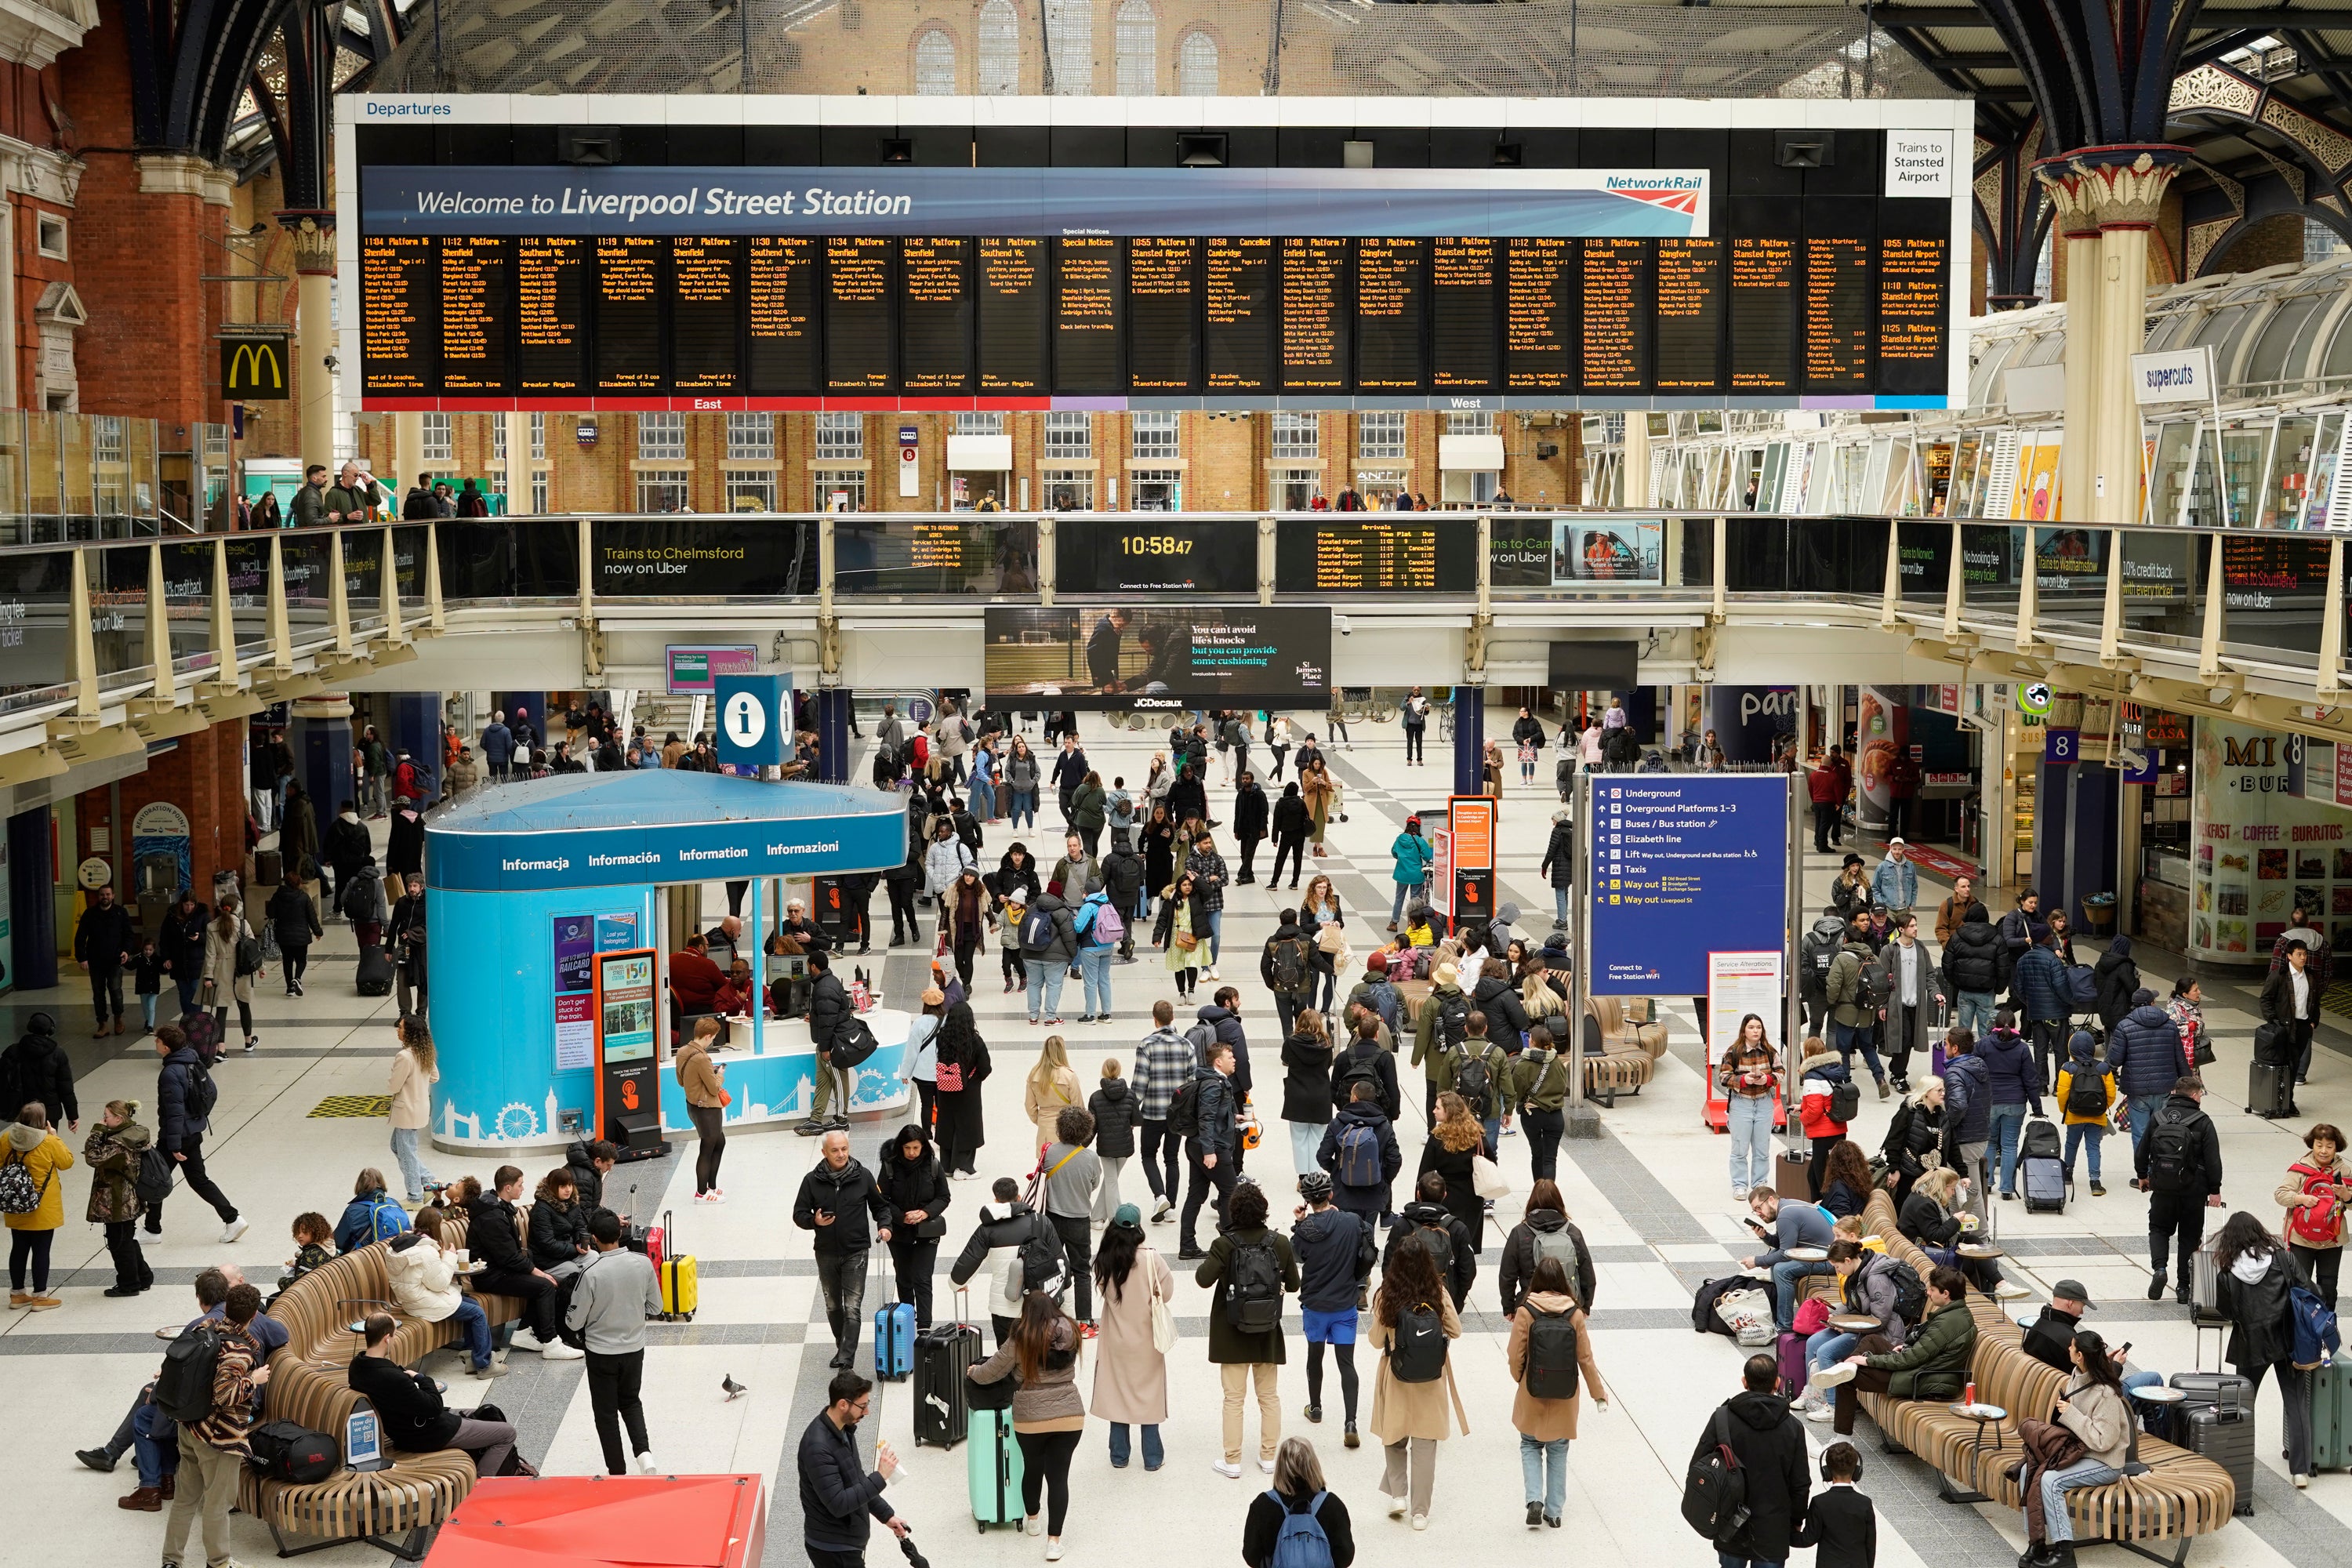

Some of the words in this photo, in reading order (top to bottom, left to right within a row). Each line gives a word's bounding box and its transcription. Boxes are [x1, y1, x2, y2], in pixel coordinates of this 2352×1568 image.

[368, 103, 450, 117] Departures
[1897, 143, 1927, 152] Trains
[1930, 144, 1942, 153] to
[1895, 157, 1944, 167] Stansted
[1899, 172, 1939, 183] Airport
[417, 191, 524, 214] Welcome
[532, 194, 554, 213] to
[561, 188, 698, 222] Liverpool
[704, 188, 795, 214] Street
[804, 188, 911, 215] Station
[364, 249, 395, 257] Shenfield
[2147, 364, 2192, 392] supercuts
[695, 399, 721, 408] East
[1450, 398, 1481, 409] West
[604, 548, 644, 559] Trains
[647, 549, 660, 559] to
[664, 547, 743, 559] Chelmsford
[1900, 546, 1911, 559] Trains
[1911, 549, 1917, 559] to
[1917, 547, 1934, 561] Norwich
[1964, 550, 1970, 563] No
[1971, 551, 1991, 567] booking
[1991, 552, 1999, 564] fee
[605, 565, 633, 574] now
[657, 562, 688, 573] Uber
[2038, 555, 2053, 569] Trains
[2053, 557, 2060, 571] to
[2060, 557, 2098, 572] Walthamstow
[2123, 561, 2136, 575] 10%
[2136, 563, 2156, 578] credit
[2157, 564, 2172, 579] back
[1964, 570, 1970, 579] on
[1970, 572, 1983, 583] every
[1984, 569, 1997, 582] ticket
[2123, 580, 2136, 595] with
[2136, 584, 2154, 601] every
[2155, 583, 2173, 599] ticket
[1210, 625, 1231, 633] can't
[1192, 635, 1212, 644] life's
[1214, 636, 1246, 644] knocks
[1243, 646, 1277, 656] provide
[1218, 657, 1267, 666] cushioning
[1134, 699, 1182, 708] JCDecaux
[2158, 713, 2178, 726] MI
[2147, 726, 2185, 739] CASA
[2056, 736, 2068, 756] 8
[1626, 789, 1680, 799] Underground
[1626, 804, 1675, 814] Overground
[136, 806, 172, 829] REHYDRATION
[172, 811, 186, 828] POINT
[1626, 835, 1664, 844] Elizabeth
[2243, 826, 2280, 841] COFFEE
[2292, 824, 2343, 842] BURRITOS
[680, 847, 748, 861] Information
[768, 840, 838, 855] Informazioni
[503, 857, 569, 871] Informacja
[589, 851, 660, 866] Información
[1624, 880, 1642, 890] Way
[1624, 896, 1642, 905] Way
[2258, 890, 2287, 912] MEXICO
[616, 931, 627, 939] your
[559, 958, 590, 973] RAILCARD
[625, 961, 648, 979] 150
[1044, 1273, 1064, 1294] NIKE
